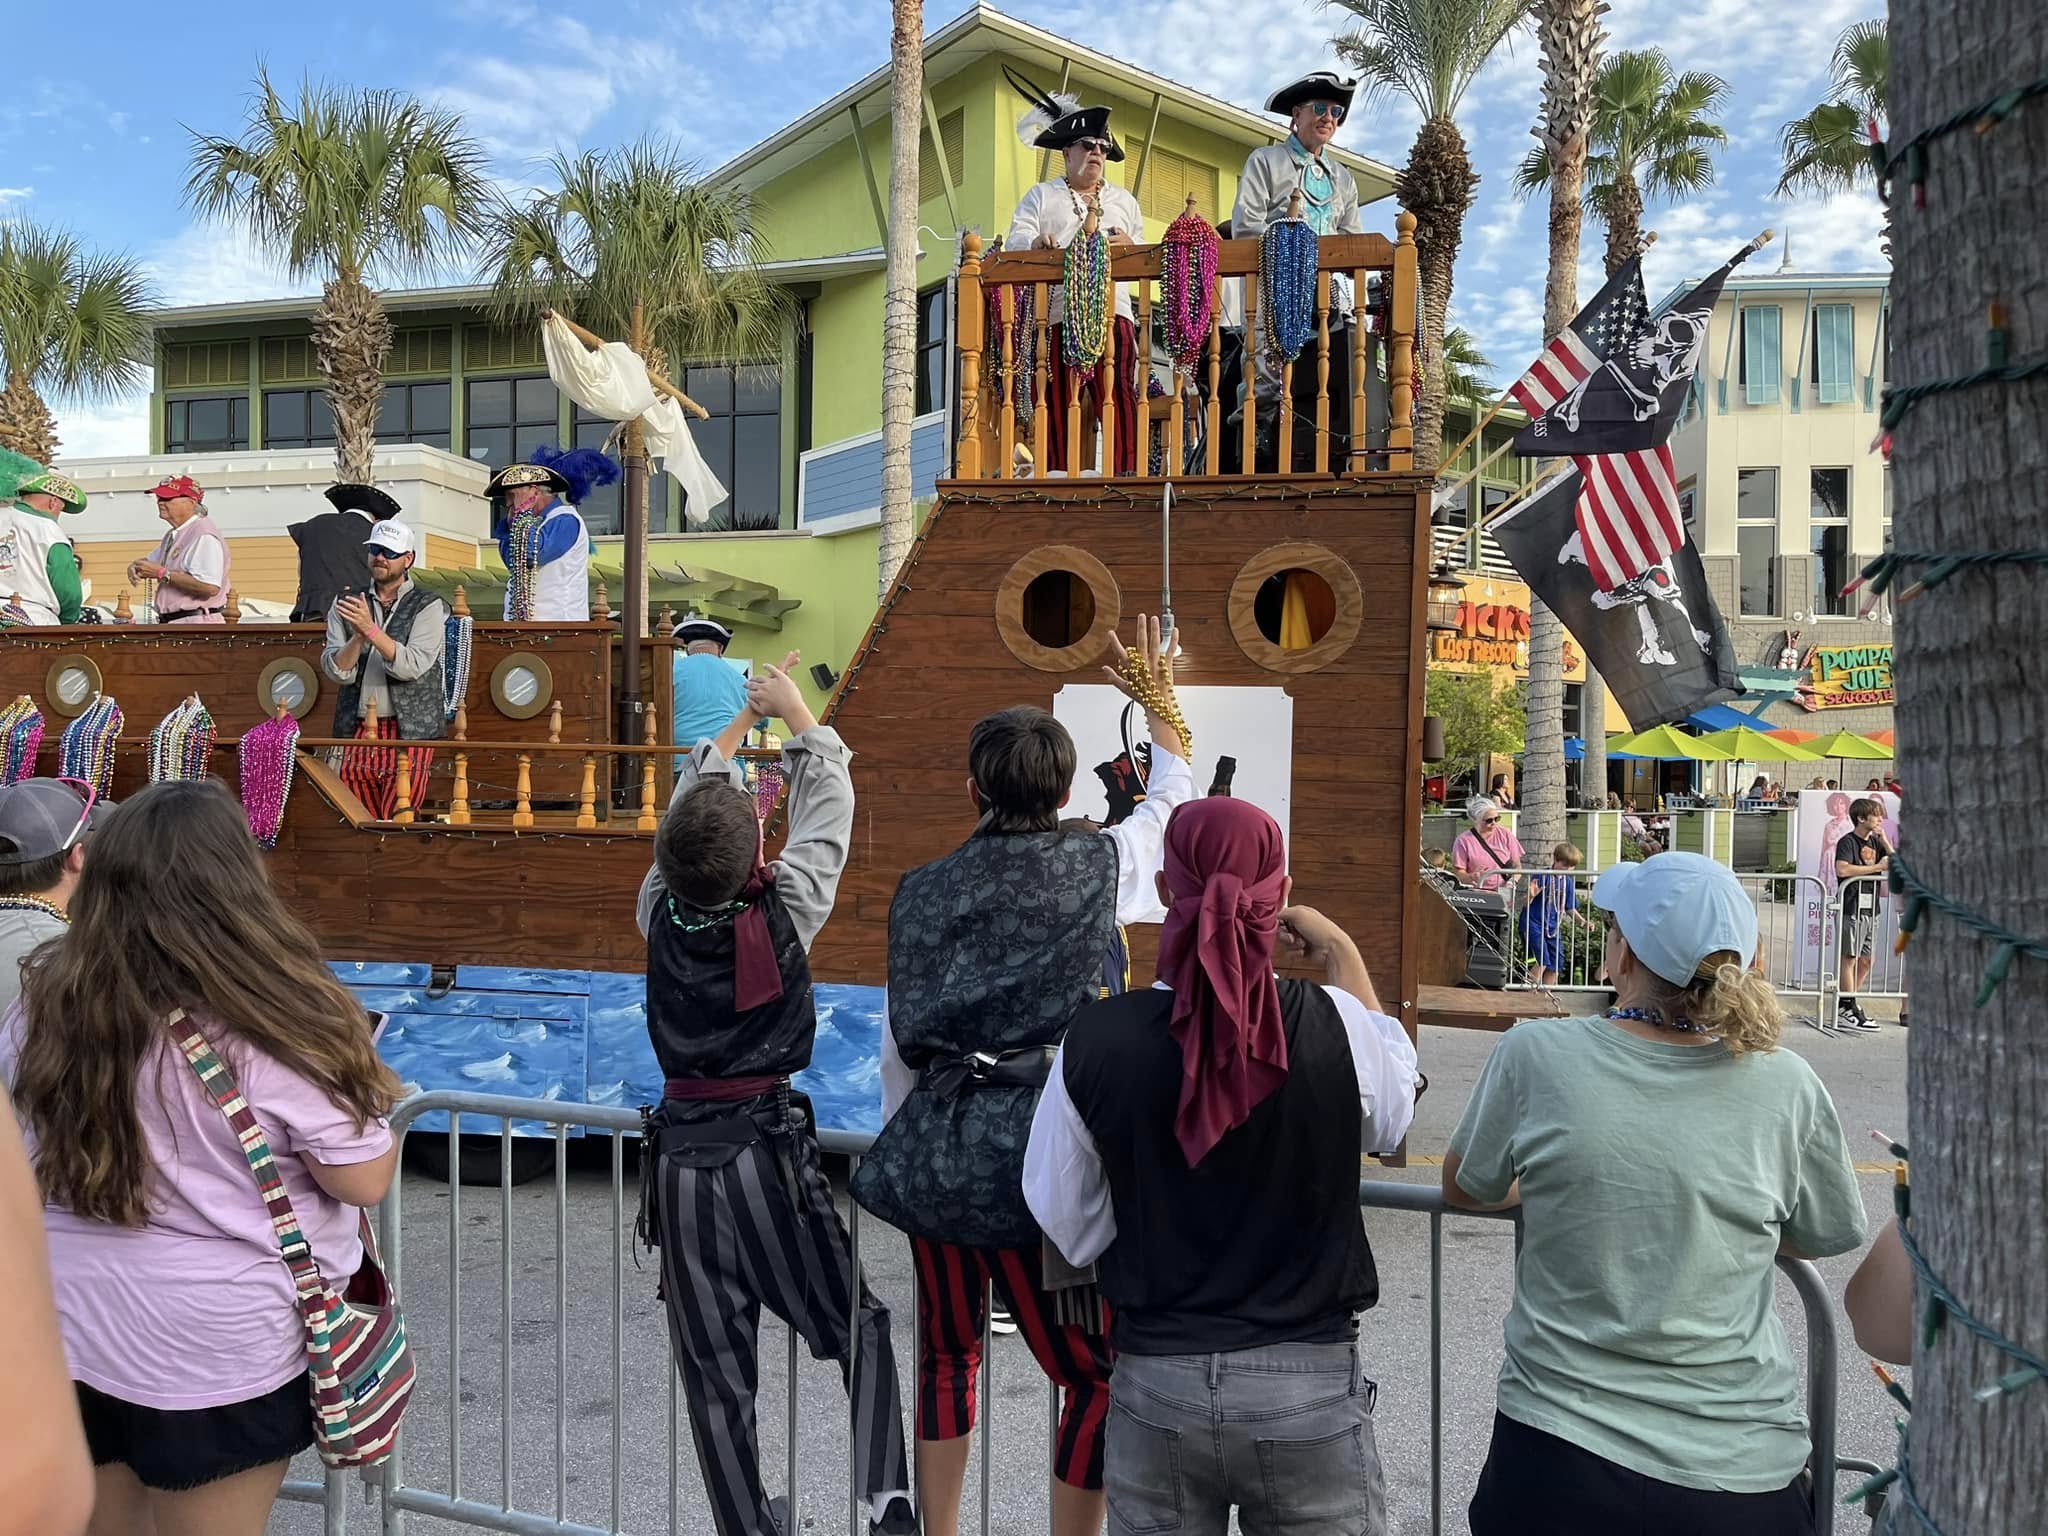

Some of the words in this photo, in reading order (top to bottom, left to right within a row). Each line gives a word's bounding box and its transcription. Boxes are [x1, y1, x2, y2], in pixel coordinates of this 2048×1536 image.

[1436, 637, 1471, 661] LAST
[1473, 639, 1517, 665] RESORT
[1819, 648, 1893, 681] POMPA
[1842, 668, 1892, 691] JOE
